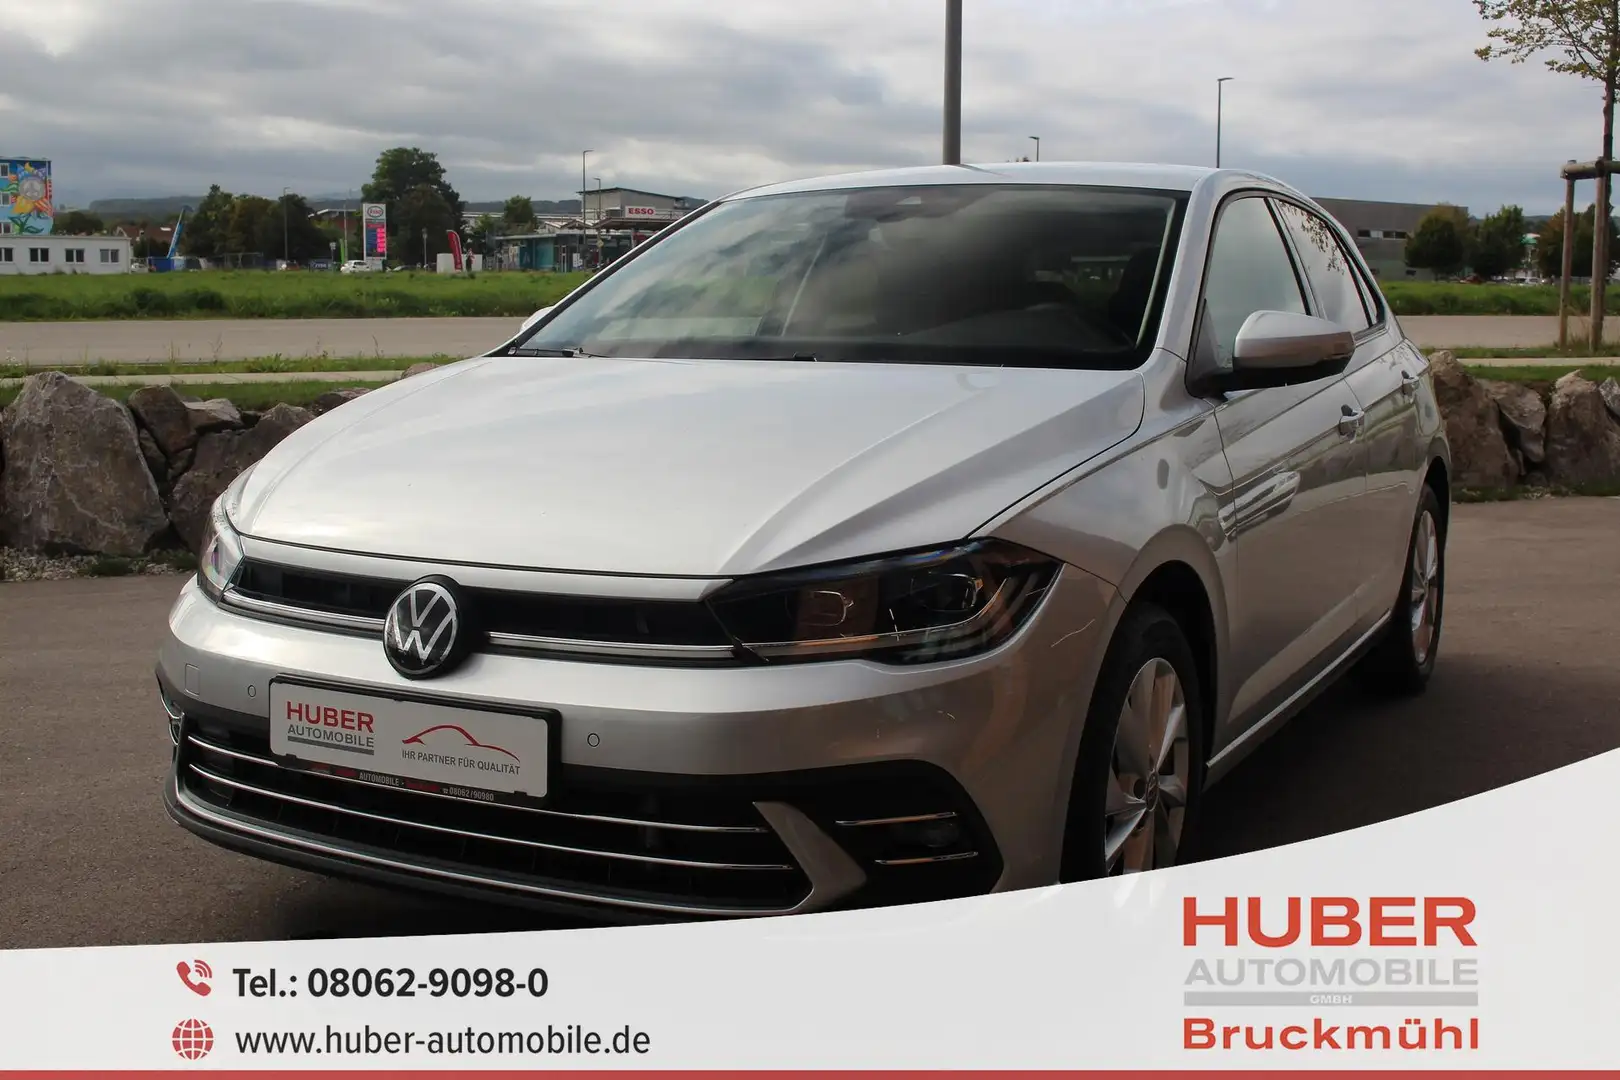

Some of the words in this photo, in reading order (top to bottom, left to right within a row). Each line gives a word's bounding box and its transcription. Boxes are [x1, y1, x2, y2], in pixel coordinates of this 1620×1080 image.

[628, 207, 654, 215] ESSO
[287, 701, 374, 733] HUBER
[288, 724, 374, 748] AUTOMOBILE
[402, 749, 416, 760] IHR
[417, 752, 456, 766] PARTNER
[458, 756, 475, 769] FÜR
[477, 760, 520, 775] QUALITÄT
[359, 772, 399, 787] AUTOMOBILE
